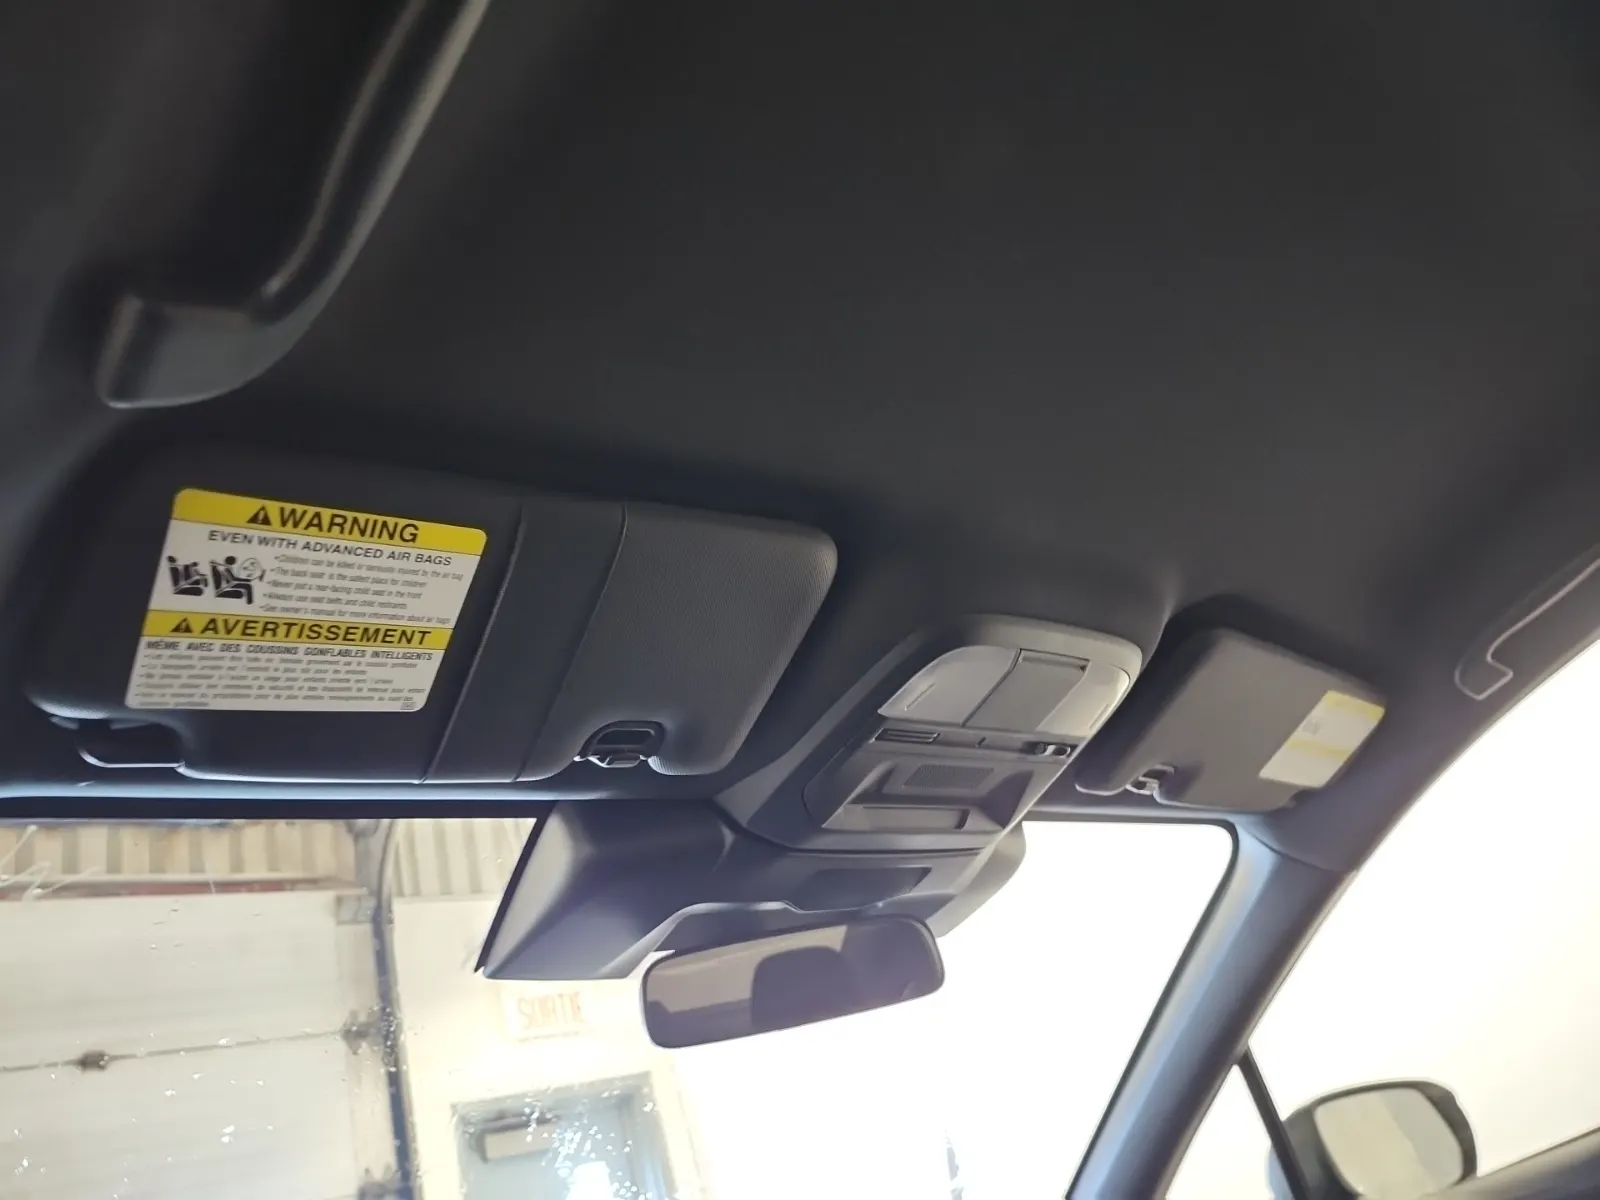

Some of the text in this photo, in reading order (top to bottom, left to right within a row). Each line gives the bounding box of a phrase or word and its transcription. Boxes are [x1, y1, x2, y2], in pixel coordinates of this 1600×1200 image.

[279, 506, 420, 544] WARNING
[208, 530, 453, 567] EVEN WITH ADVANCED AIR BAGS
[200, 617, 432, 646] AVERTISSEMENT
[185, 642, 215, 652] AVEC
[218, 643, 242, 653] DES
[245, 644, 300, 656] COUSSINS
[370, 650, 433, 661] INTELLIGENTS
